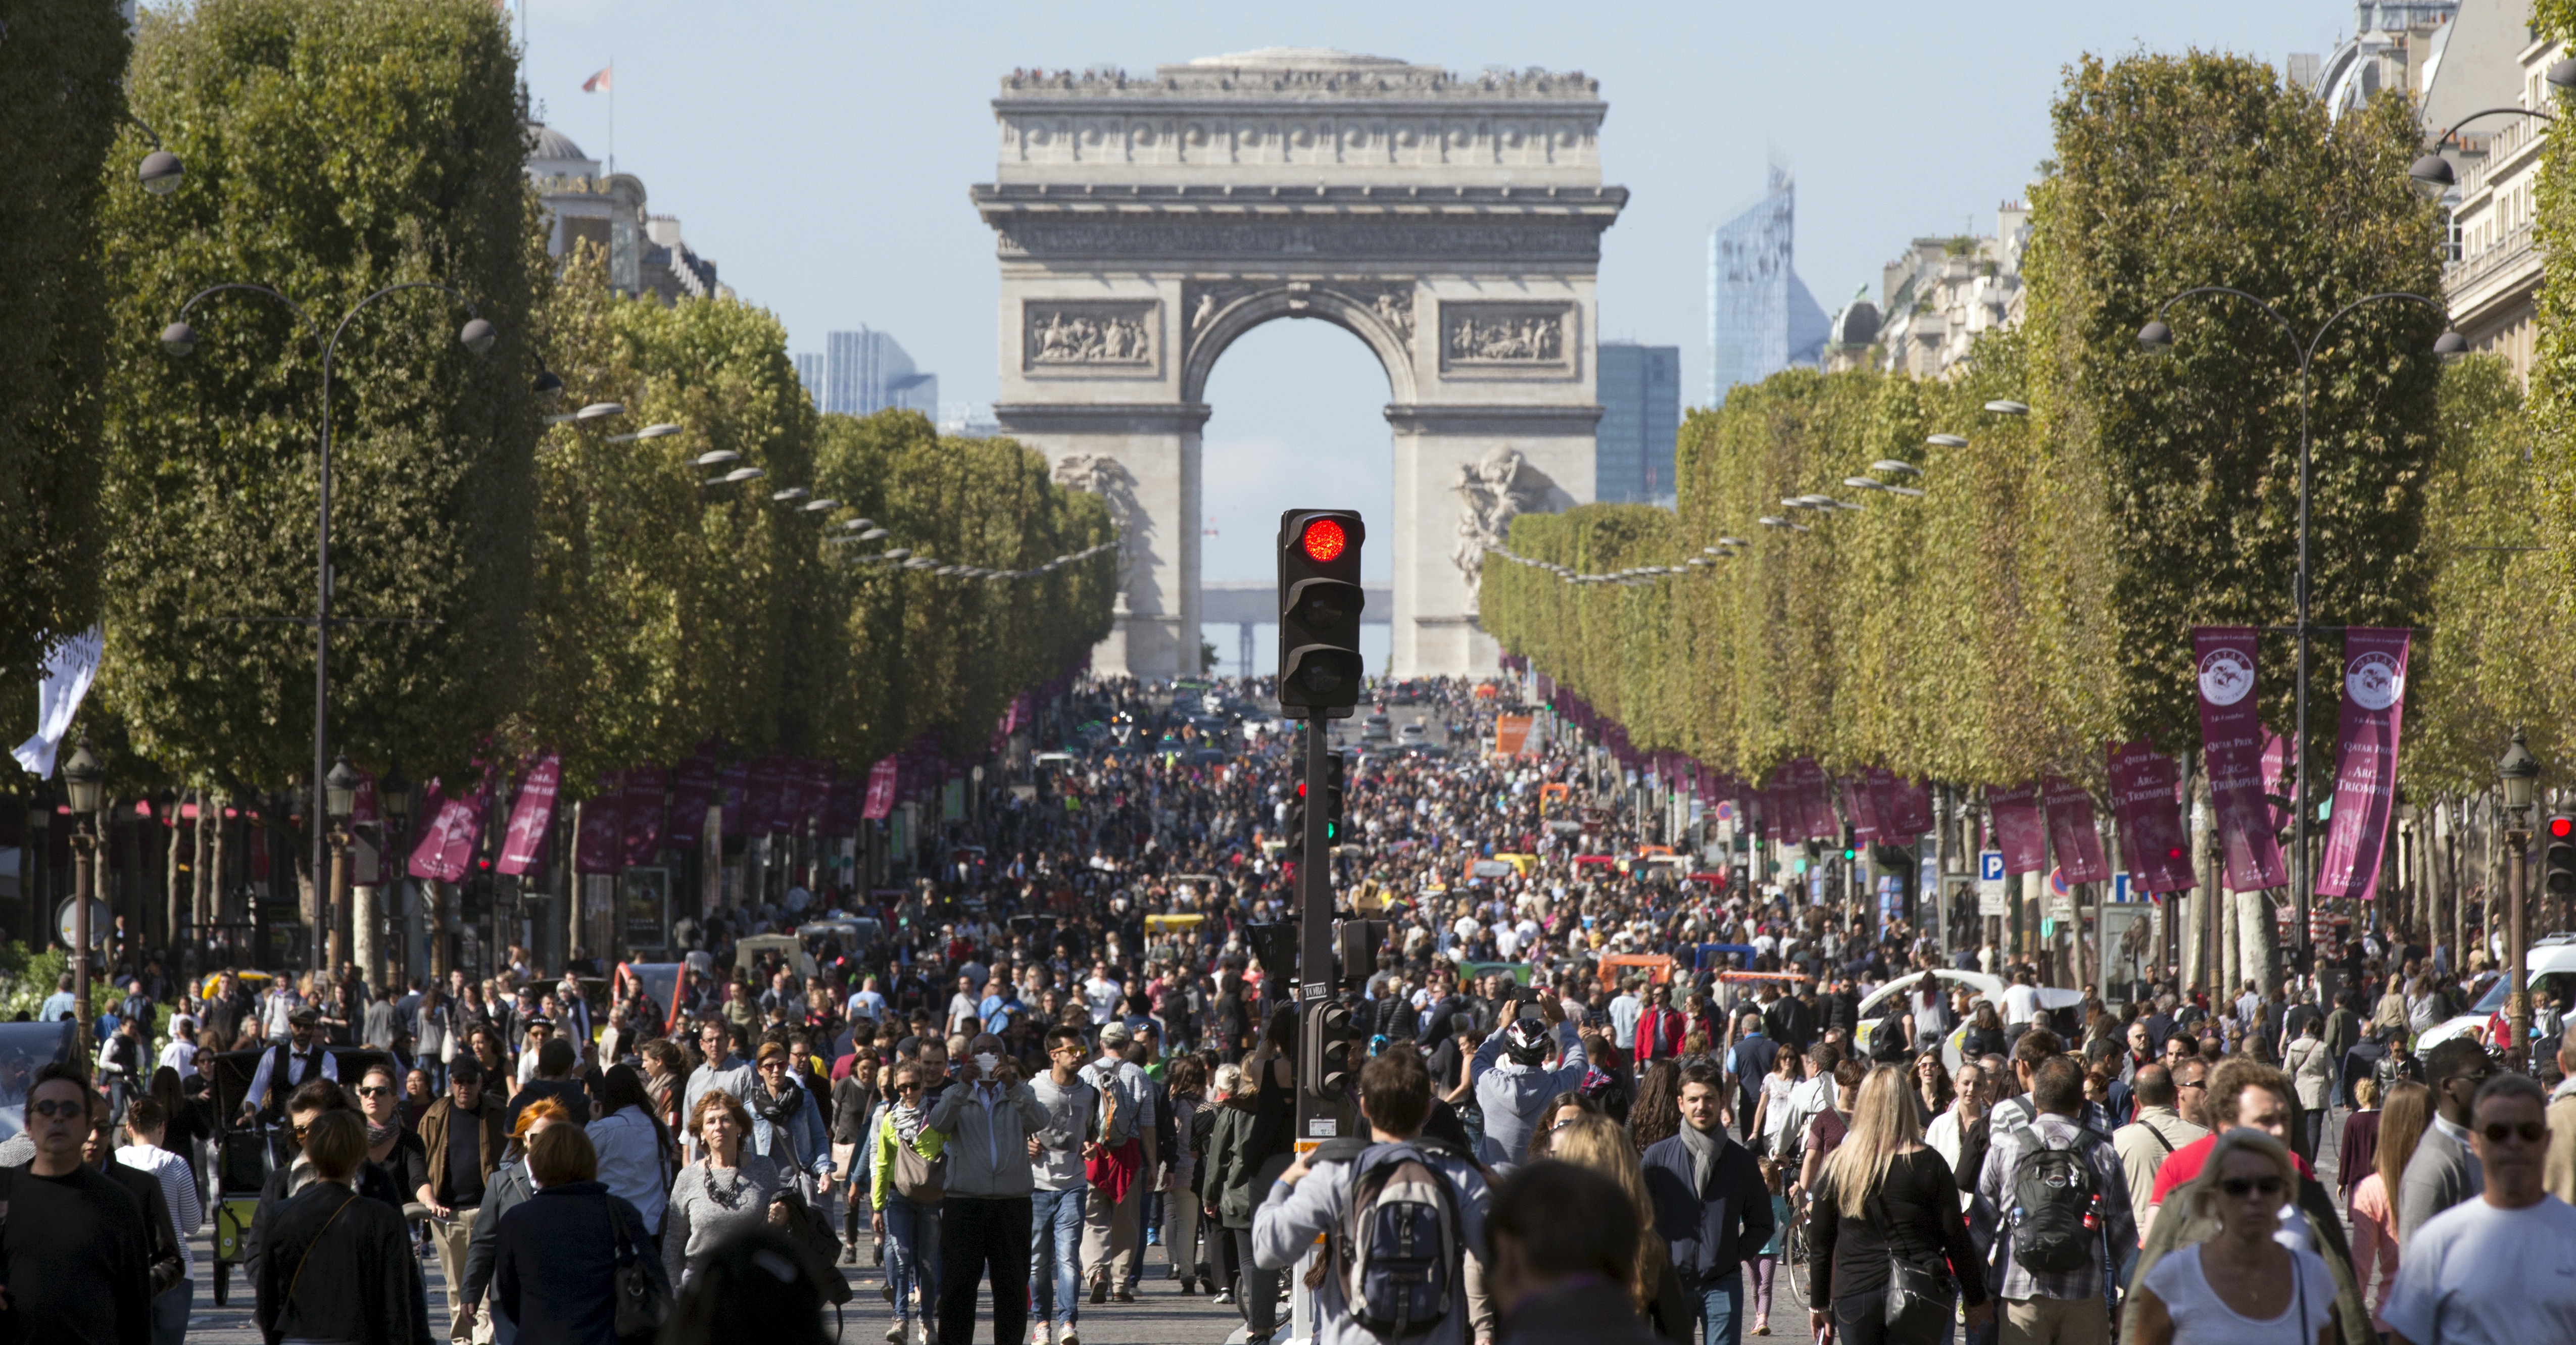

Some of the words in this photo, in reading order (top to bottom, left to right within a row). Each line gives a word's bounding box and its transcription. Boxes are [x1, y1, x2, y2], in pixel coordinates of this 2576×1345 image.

[2206, 652, 2245, 666] QATAR
[2356, 654, 2396, 669] QATAR
[2207, 740, 2232, 752] QATAR
[2234, 737, 2253, 748] PRIX
[2344, 741, 2372, 753] QATAR
[2124, 754, 2148, 766] QATAR
[2211, 776, 2262, 792] TRIOMPHE
[2127, 787, 2173, 802] TRIOMPHE
[1988, 857, 2003, 878] P
[1304, 985, 1327, 997] TORO
